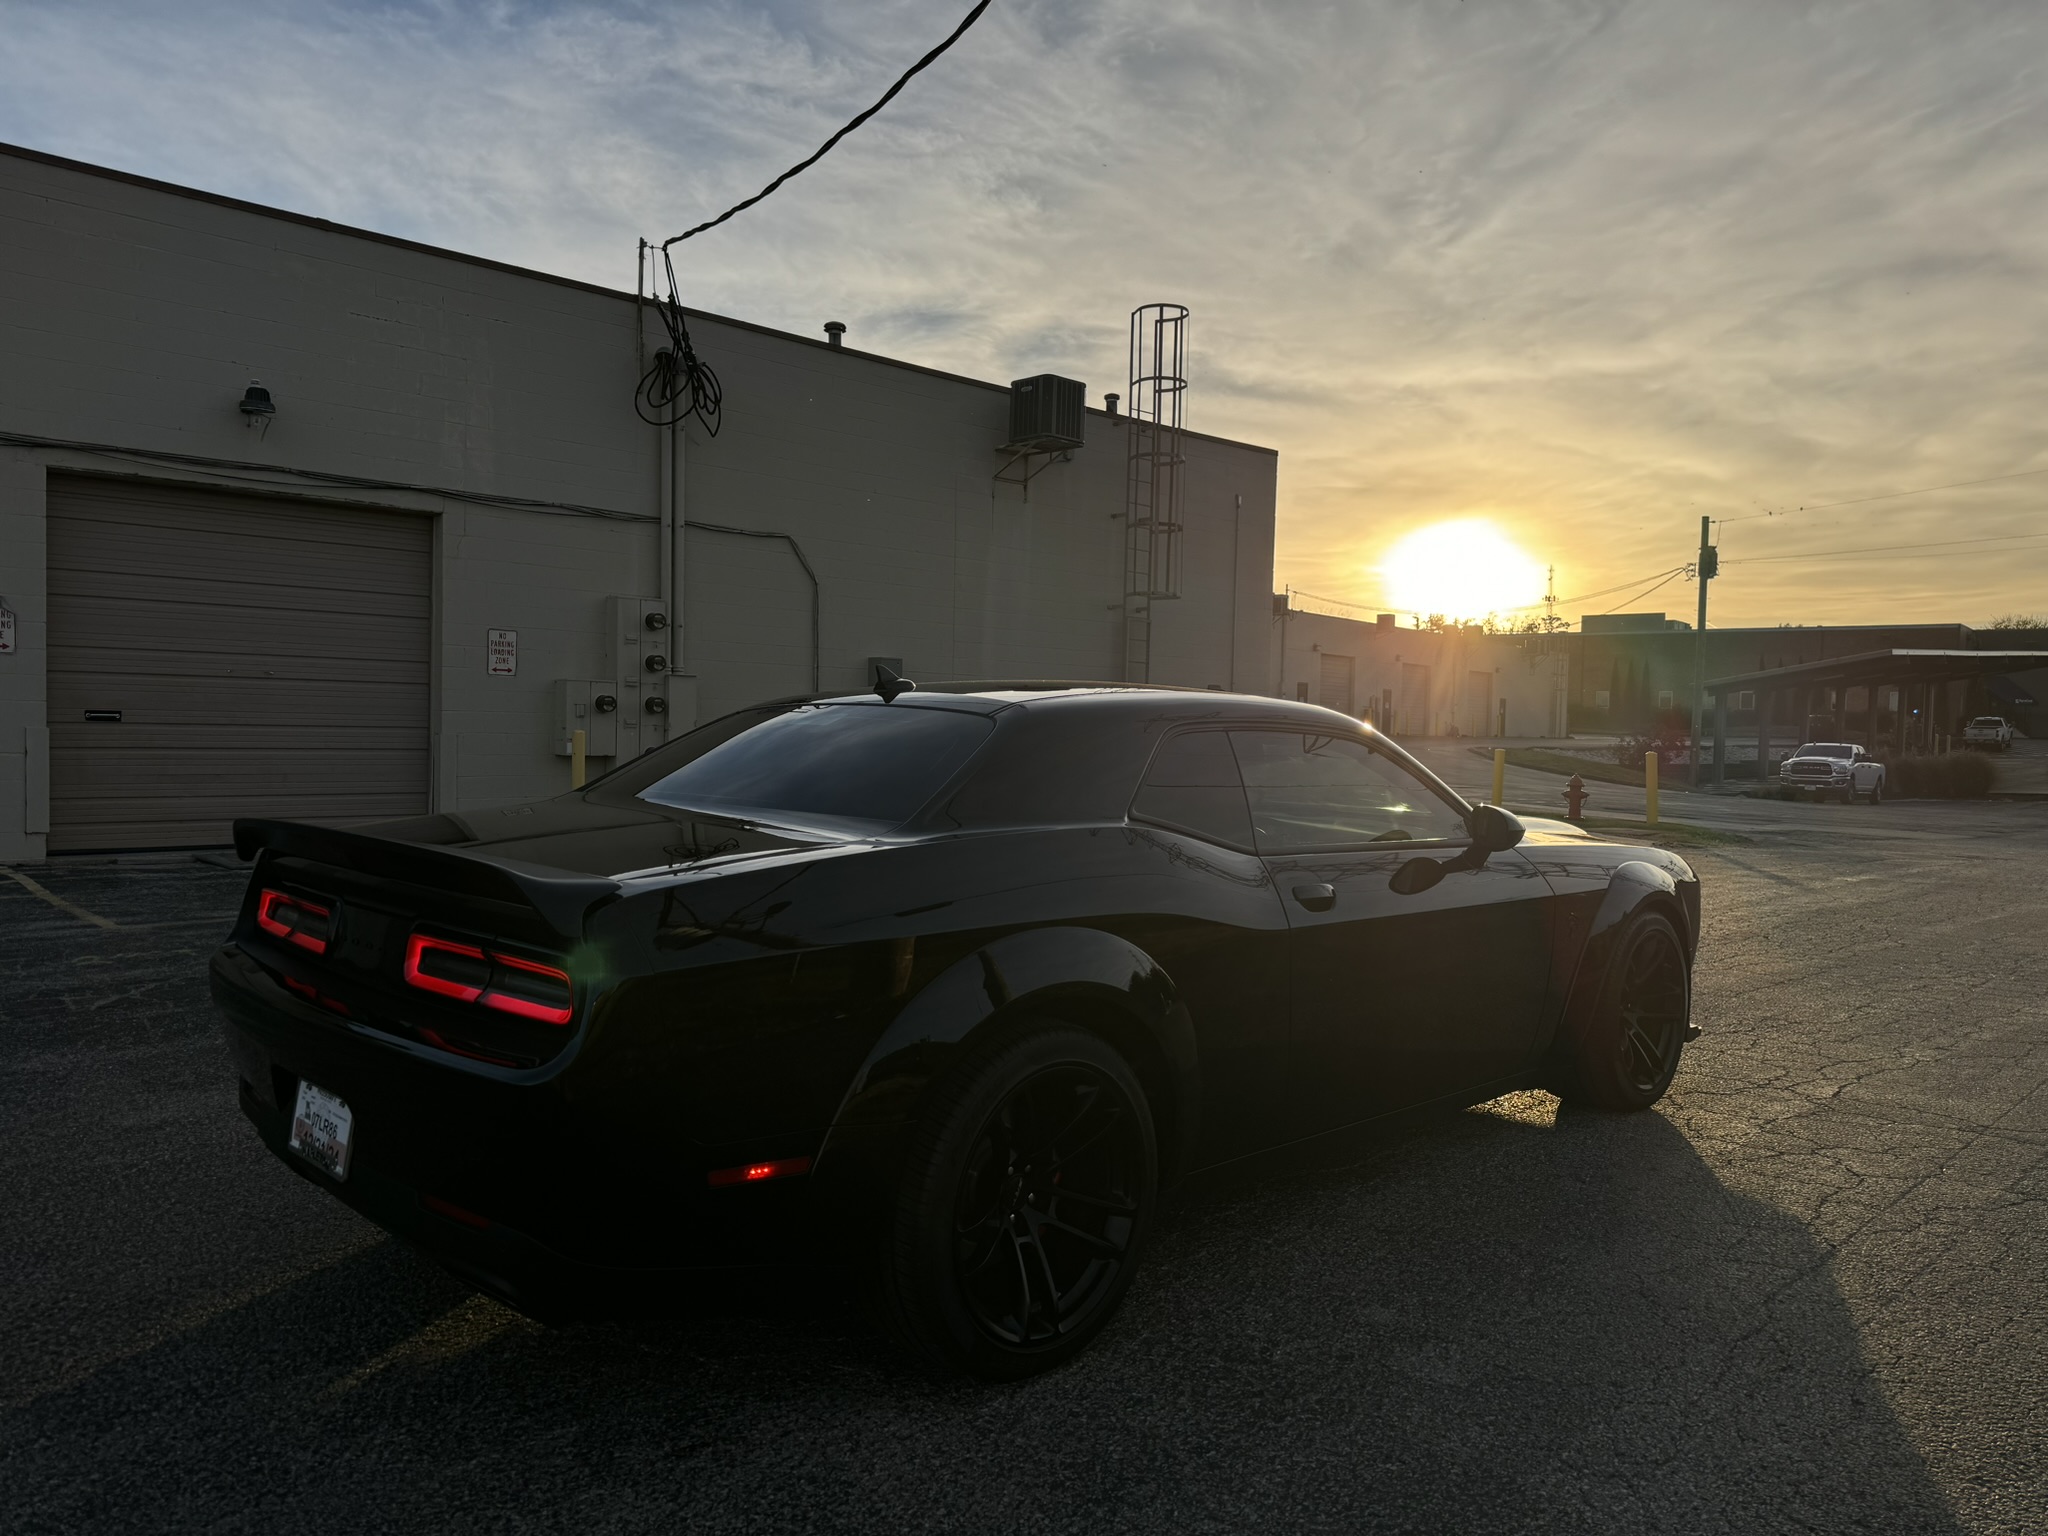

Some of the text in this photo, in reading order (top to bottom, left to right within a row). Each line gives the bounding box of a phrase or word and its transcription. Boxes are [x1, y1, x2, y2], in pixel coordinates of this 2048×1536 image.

[498, 632, 507, 640] NO
[490, 640, 514, 649] PARKING
[490, 648, 514, 657] LOADING
[495, 657, 509, 665] ZONE
